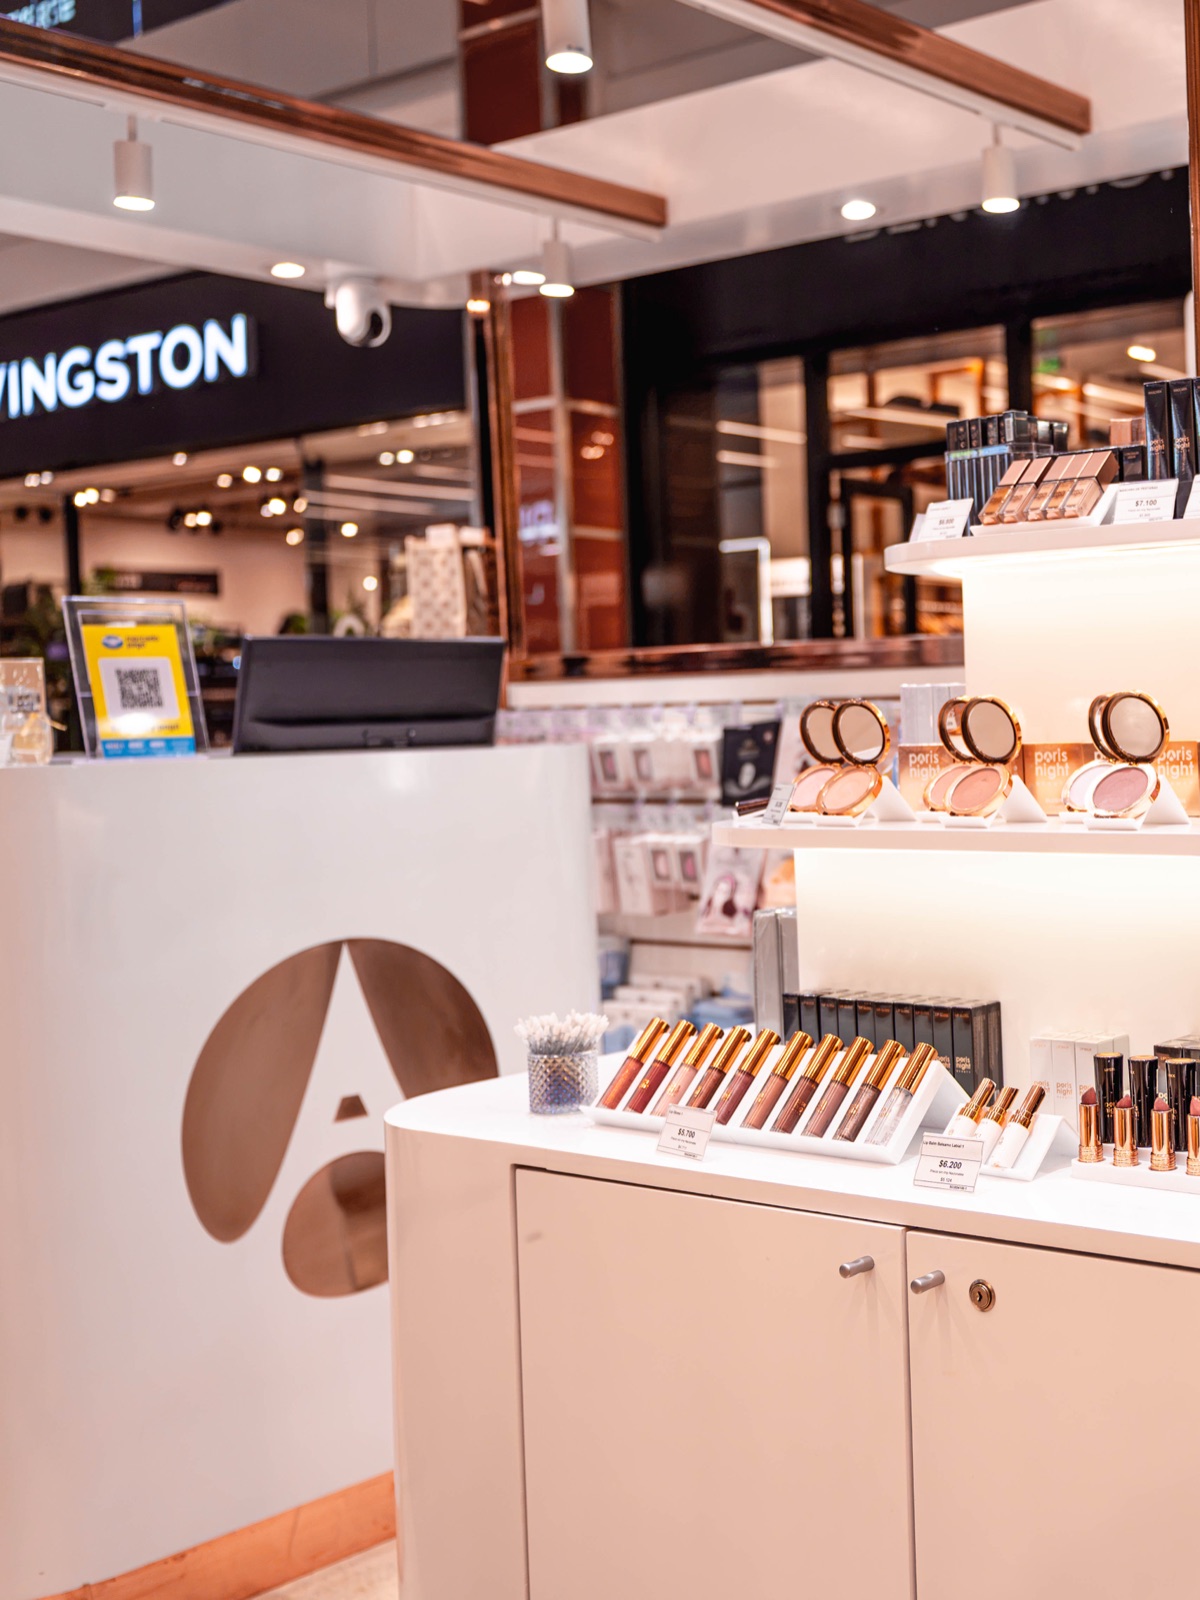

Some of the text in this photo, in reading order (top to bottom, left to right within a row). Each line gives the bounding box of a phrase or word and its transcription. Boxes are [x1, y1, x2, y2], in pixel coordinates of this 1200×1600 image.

[1135, 499, 1157, 507] $7.100
[1035, 762, 1070, 779] night
[678, 1128, 696, 1139] $5.700
[939, 1160, 962, 1169] $6.200
